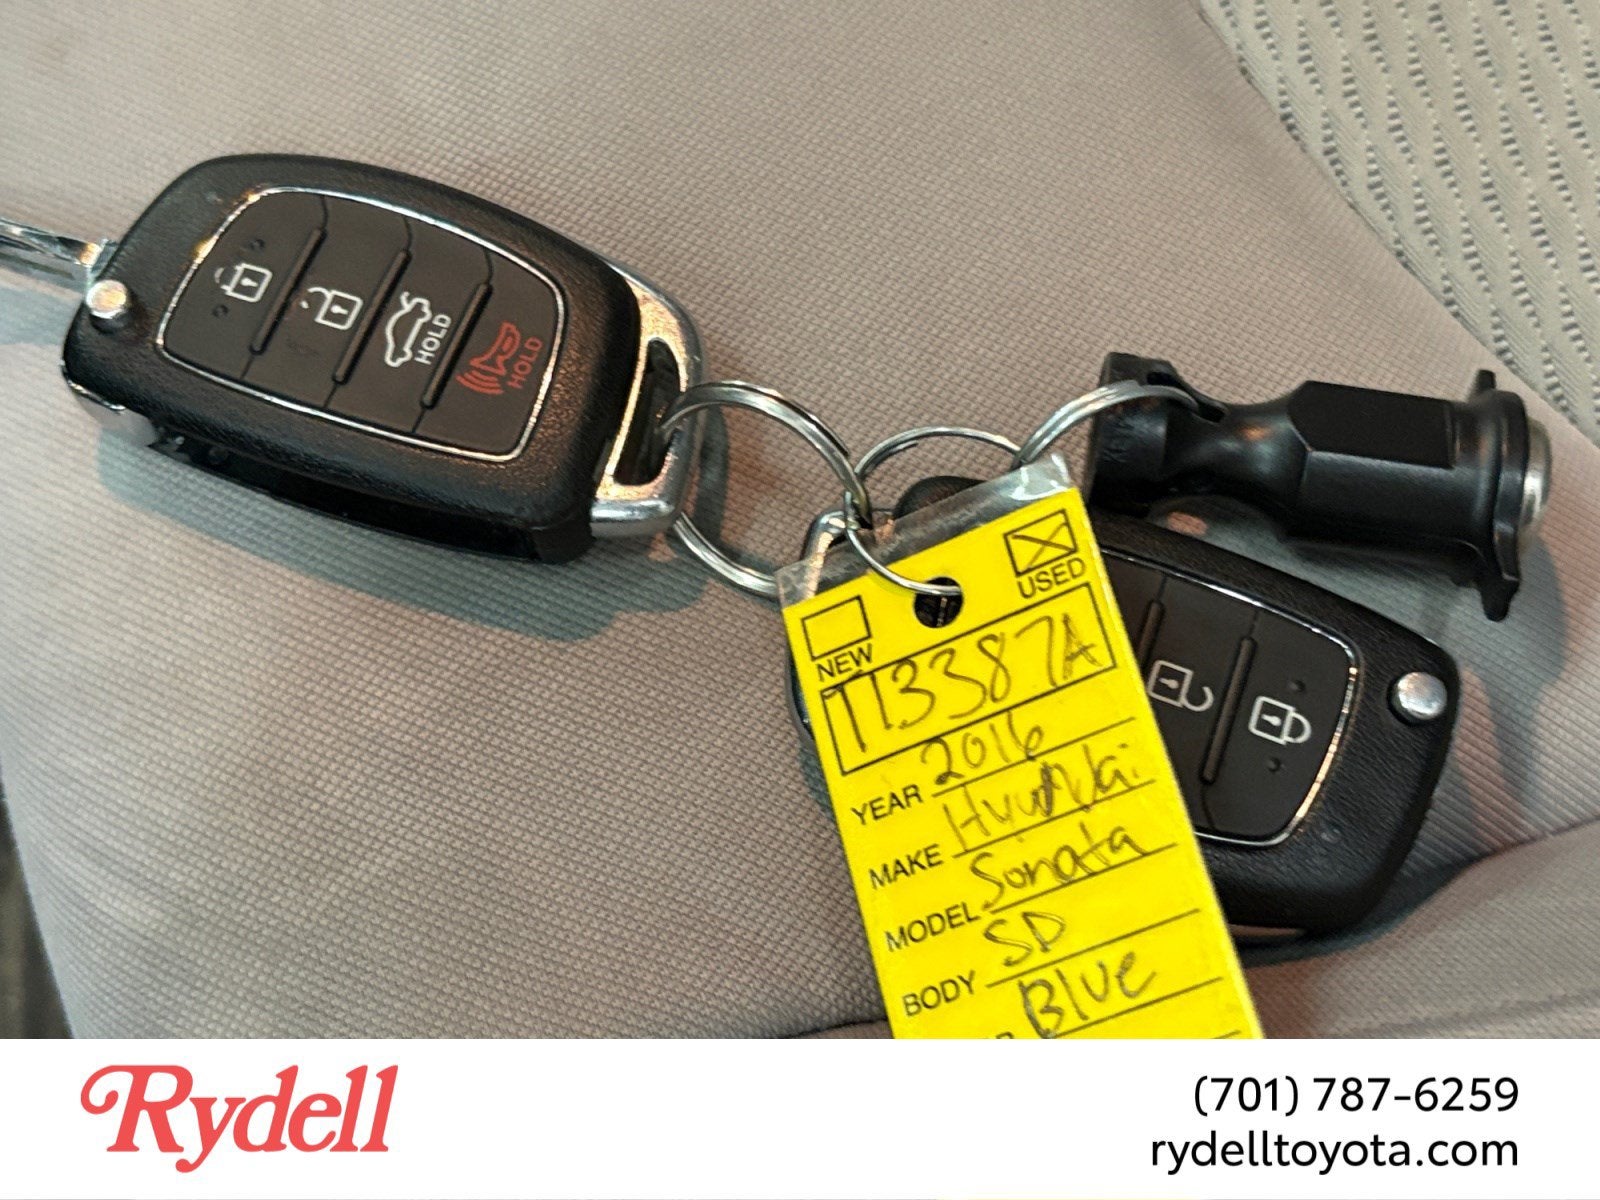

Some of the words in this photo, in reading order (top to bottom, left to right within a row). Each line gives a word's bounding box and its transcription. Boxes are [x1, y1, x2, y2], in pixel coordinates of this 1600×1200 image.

[414, 313, 452, 365] HOLD
[506, 336, 543, 389] HOLD
[1018, 557, 1086, 599] USED
[816, 643, 875, 682] NEW
[920, 710, 1044, 785] 2016
[851, 784, 924, 826] YEAR
[868, 844, 944, 890] MAKE
[969, 822, 1151, 910] Sonata
[885, 901, 982, 952] MODEL
[983, 911, 1067, 967] SD
[902, 970, 976, 1018] BODY
